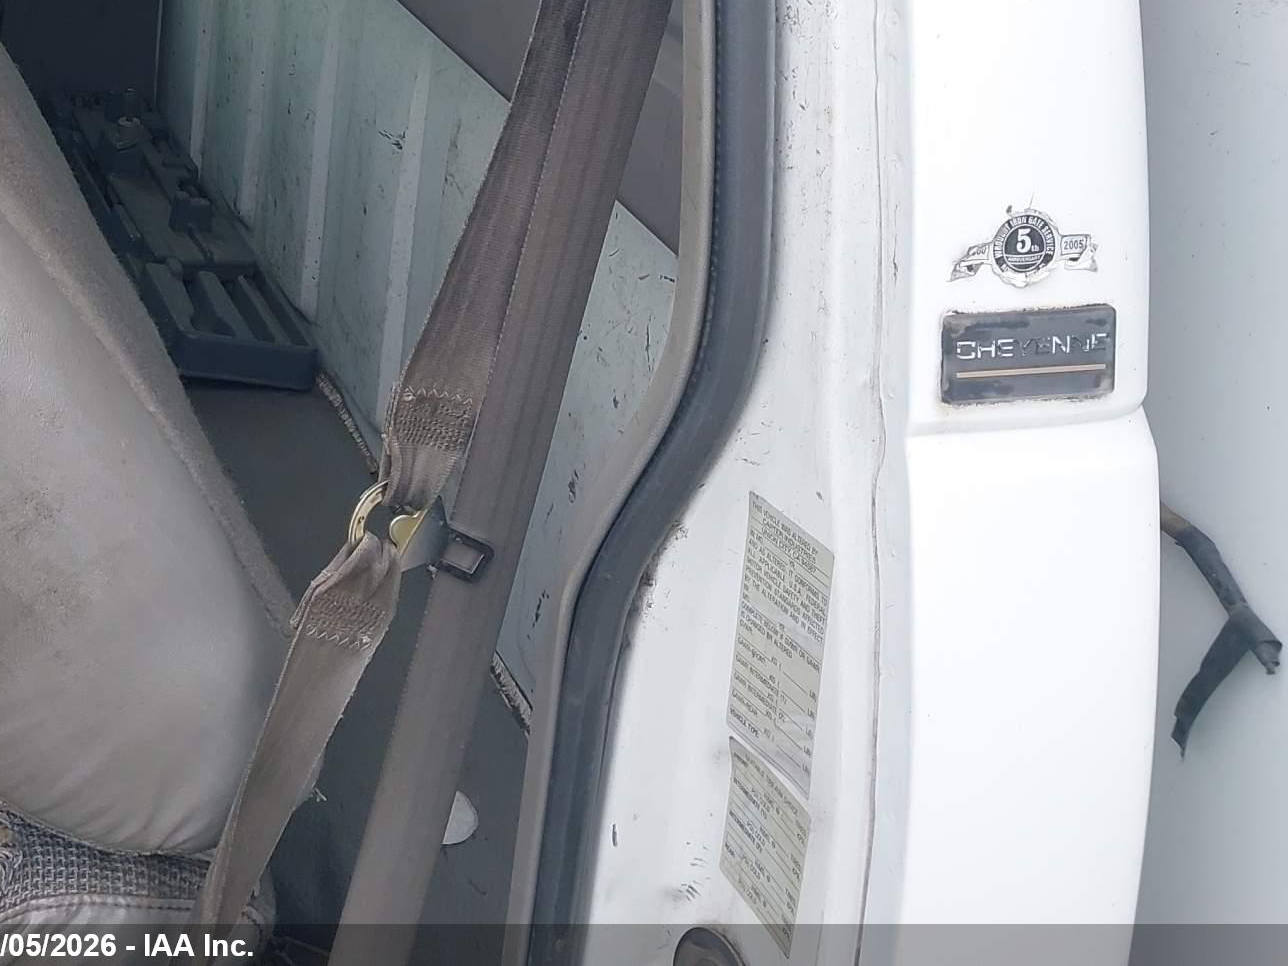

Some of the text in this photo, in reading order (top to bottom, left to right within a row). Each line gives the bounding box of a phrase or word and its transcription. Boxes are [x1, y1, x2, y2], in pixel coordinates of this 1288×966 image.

[1010, 216, 1027, 228] IRON
[1028, 216, 1045, 229] GATE
[1042, 225, 1053, 255] SERVICE
[1064, 240, 1084, 251] 2005
[956, 333, 1108, 360] CHEYENNE
[763, 508, 780, 527] VEHICLE
[792, 531, 810, 551] ALTERED
[763, 569, 781, 590] VEHICLE
[761, 588, 788, 615] ALTERATION
[802, 611, 823, 635] AFFECTED
